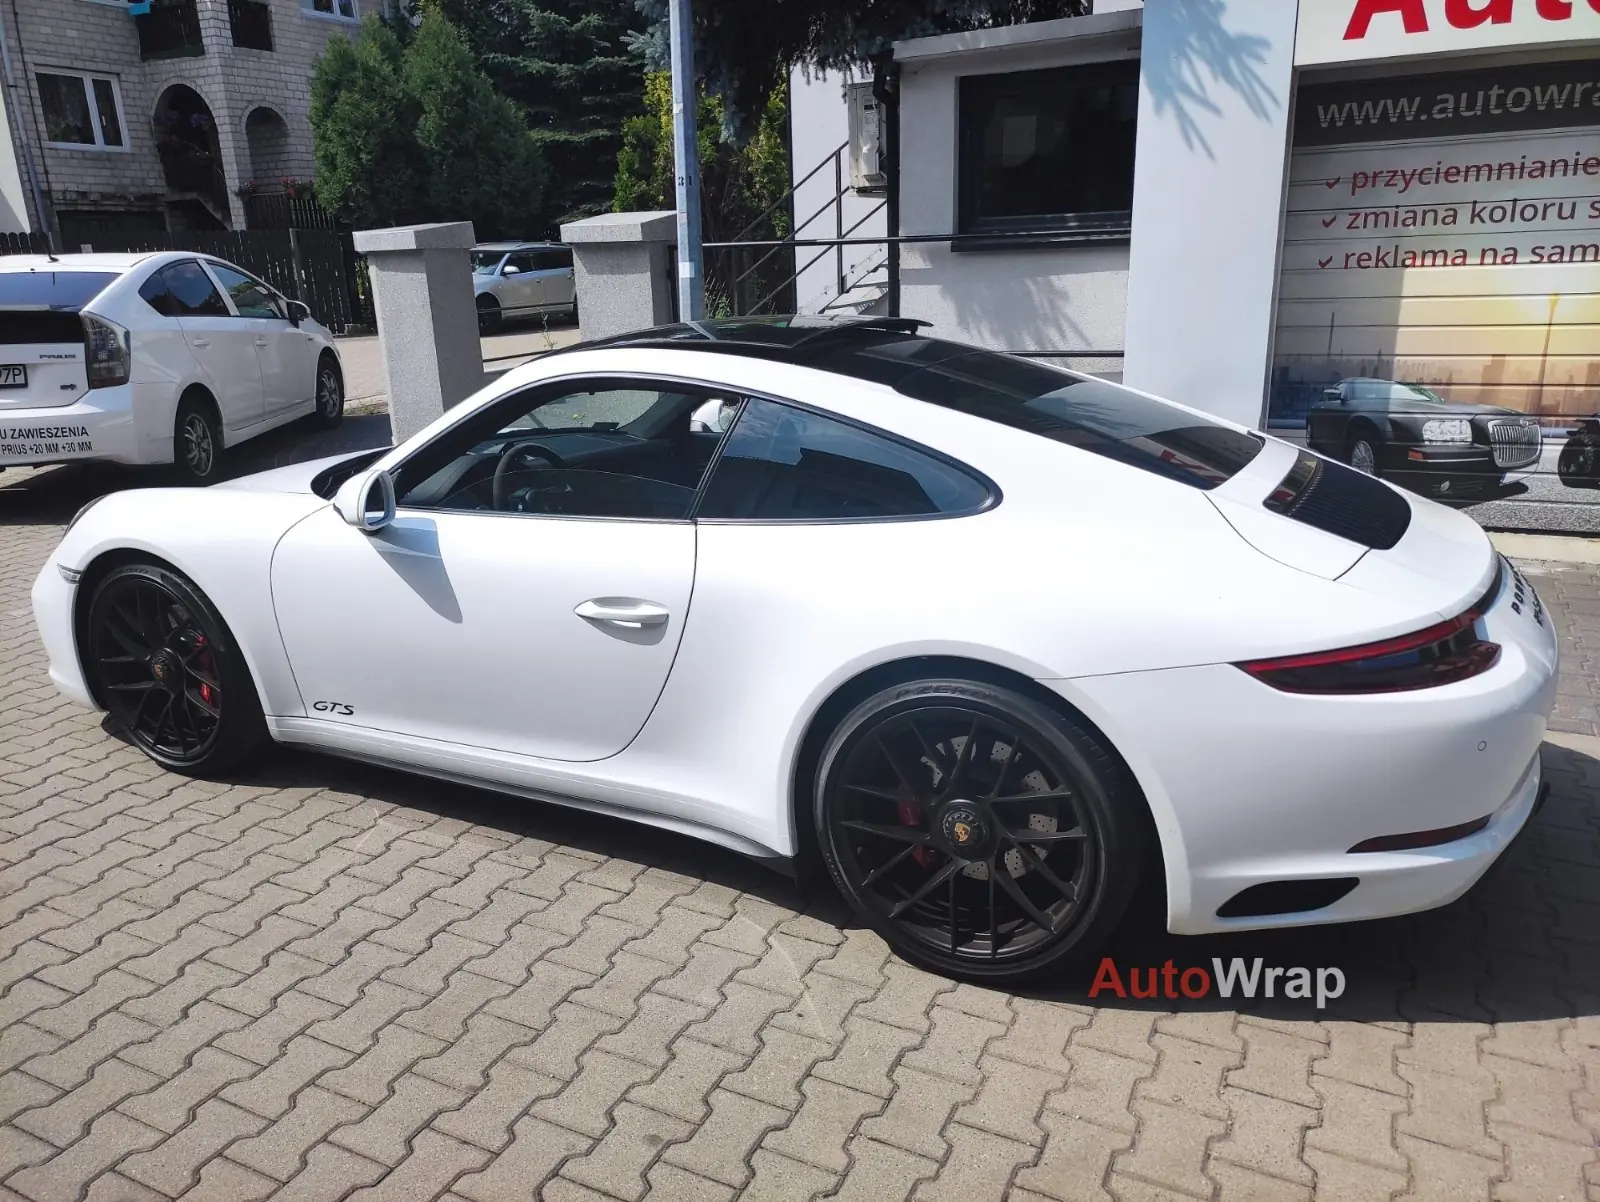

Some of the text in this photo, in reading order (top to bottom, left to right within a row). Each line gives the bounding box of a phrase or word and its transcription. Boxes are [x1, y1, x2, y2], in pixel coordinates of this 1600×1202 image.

[1350, 151, 1600, 196] przyciemnianie
[1346, 205, 1458, 230] zmiana
[1469, 198, 1577, 225] koloru
[1343, 243, 1600, 270] reklama na sam
[0, 367, 22, 383] 7P
[10, 426, 89, 440] ZAWIESZENIA
[1, 440, 93, 455] PRIUS +20 MM +30 MM
[313, 701, 354, 716] GTS
